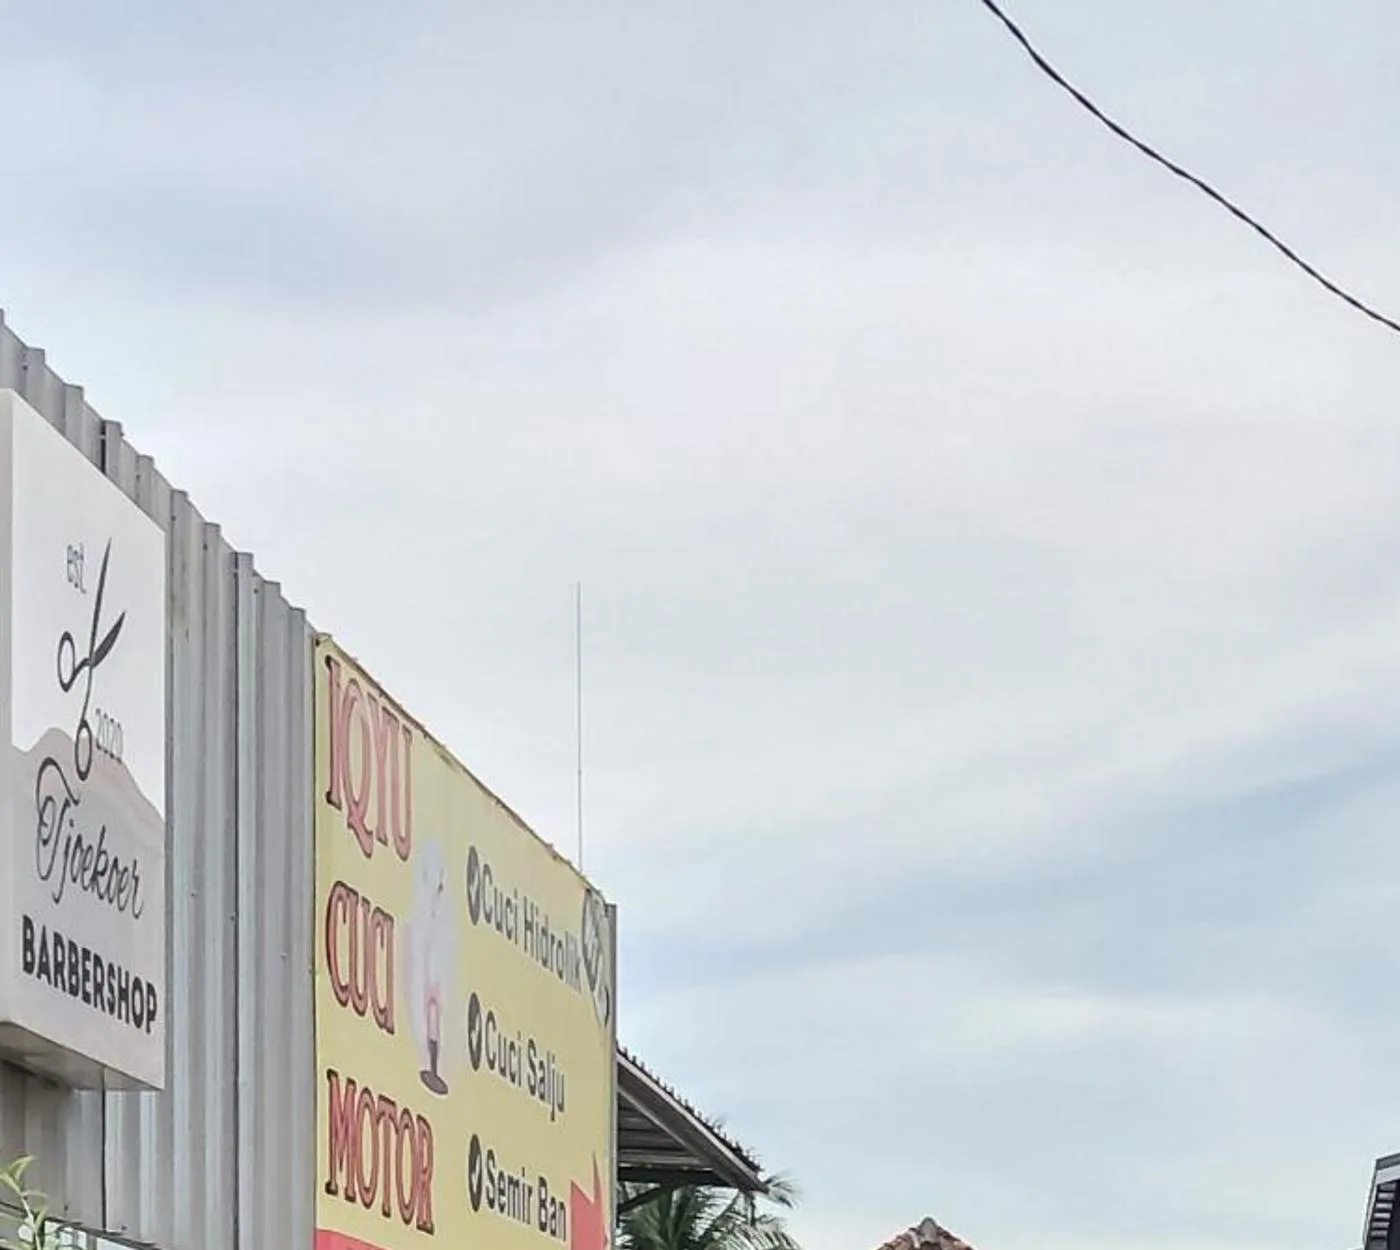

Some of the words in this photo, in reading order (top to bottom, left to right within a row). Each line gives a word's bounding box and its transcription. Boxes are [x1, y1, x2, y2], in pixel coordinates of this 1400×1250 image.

[95, 707, 125, 764] 2020
[36, 757, 144, 919] Tjoekoer
[326, 880, 395, 1036] CUCI
[482, 863, 519, 945] Cuci
[22, 914, 157, 1034] BARBERSHOP
[485, 1010, 522, 1088] Cuci
[527, 1037, 566, 1123] Salju
[325, 1067, 435, 1235] MOTOR
[485, 1148, 533, 1226] Semir
[538, 1176, 567, 1243] Ban
